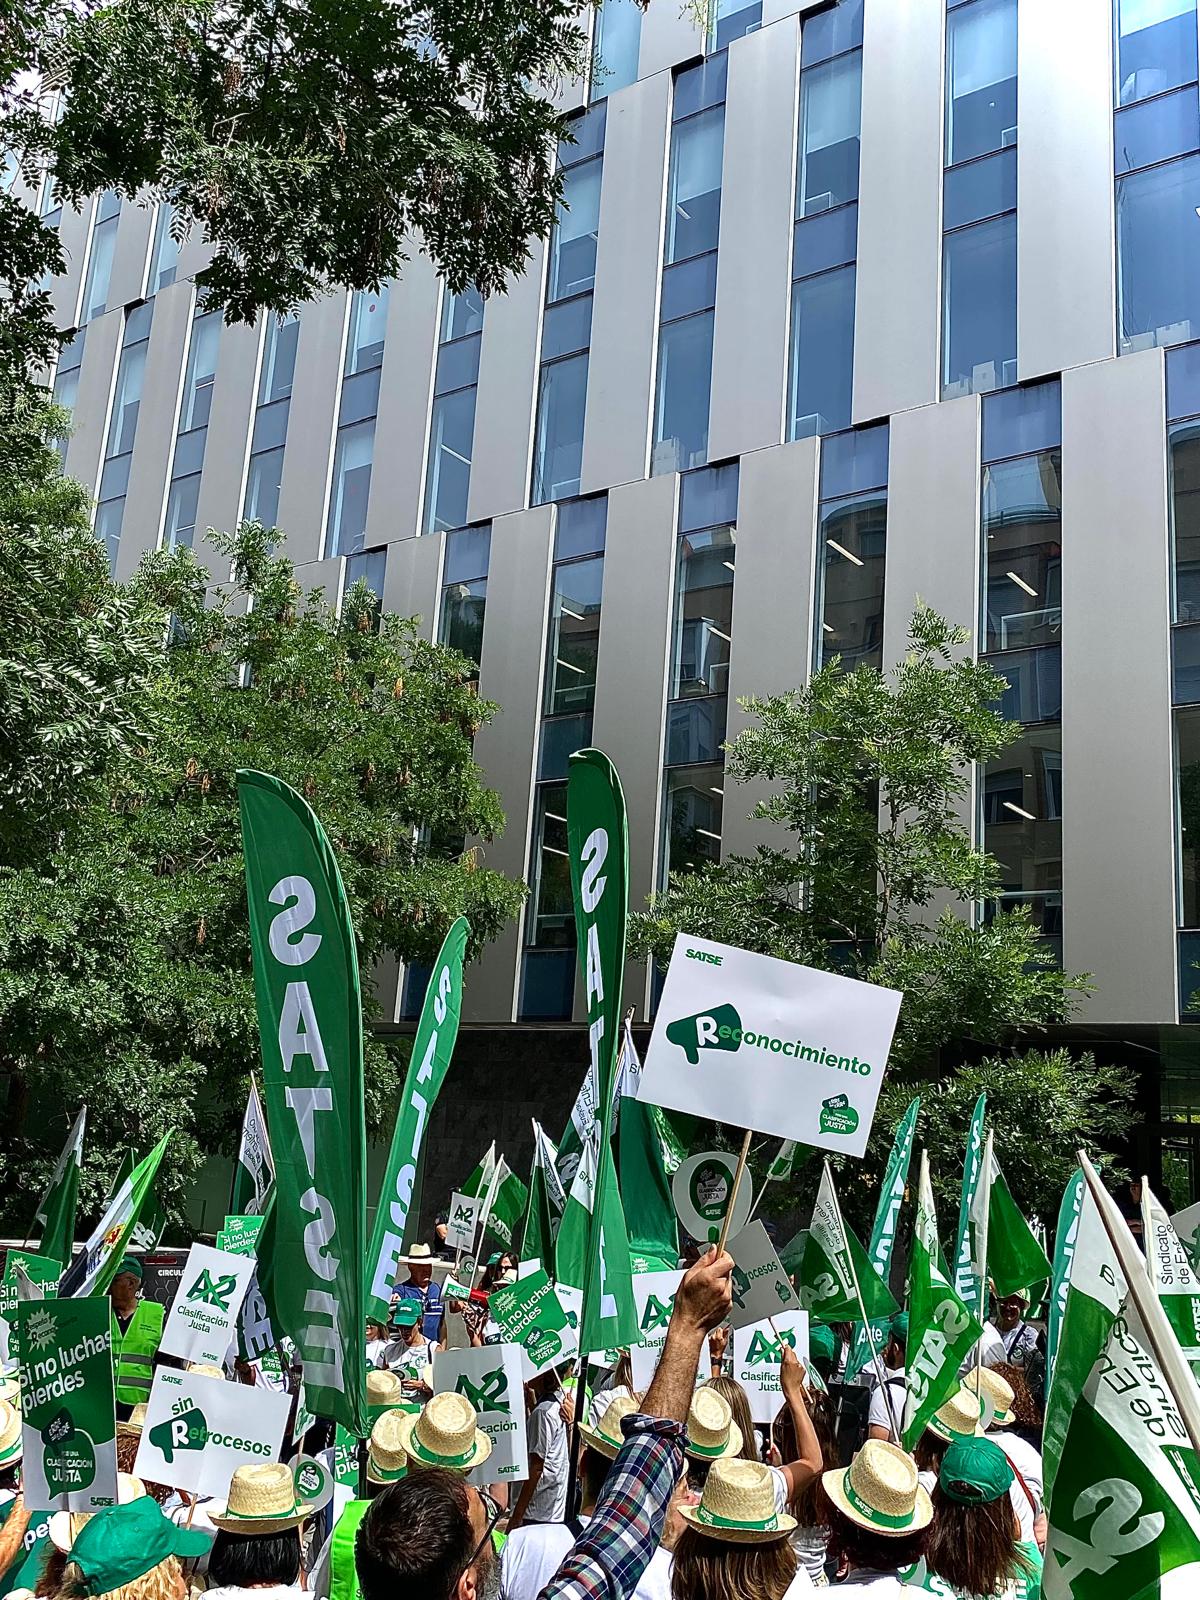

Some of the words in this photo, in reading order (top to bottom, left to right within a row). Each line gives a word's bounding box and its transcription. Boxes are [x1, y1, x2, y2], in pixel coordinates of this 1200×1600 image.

[685, 948, 724, 967] SATSE
[695, 1015, 872, 1077] Reconocimiento
[824, 1121, 847, 1131] JUSTA
[705, 1208, 721, 1216] SATSE
[232, 1233, 243, 1242] no
[1156, 1224, 1174, 1286] Sindicato
[1177, 1267, 1191, 1285] de
[508, 1310, 522, 1325] no
[520, 1280, 554, 1312] luchas
[177, 1305, 229, 1329] Clasificación
[187, 1320, 211, 1334] Justa
[34, 1357, 58, 1379] no
[59, 1330, 112, 1370] luchas
[201, 1352, 218, 1362] SATSE
[536, 1347, 555, 1361] JUSTA
[161, 1374, 184, 1387] SATSE
[741, 1371, 781, 1382] Clasifica
[22, 1370, 86, 1418] pierdes
[171, 1396, 194, 1417] sin
[171, 1418, 273, 1458] Retrocesos
[498, 1465, 521, 1475] SATSE
[90, 1496, 115, 1506] SATSE
